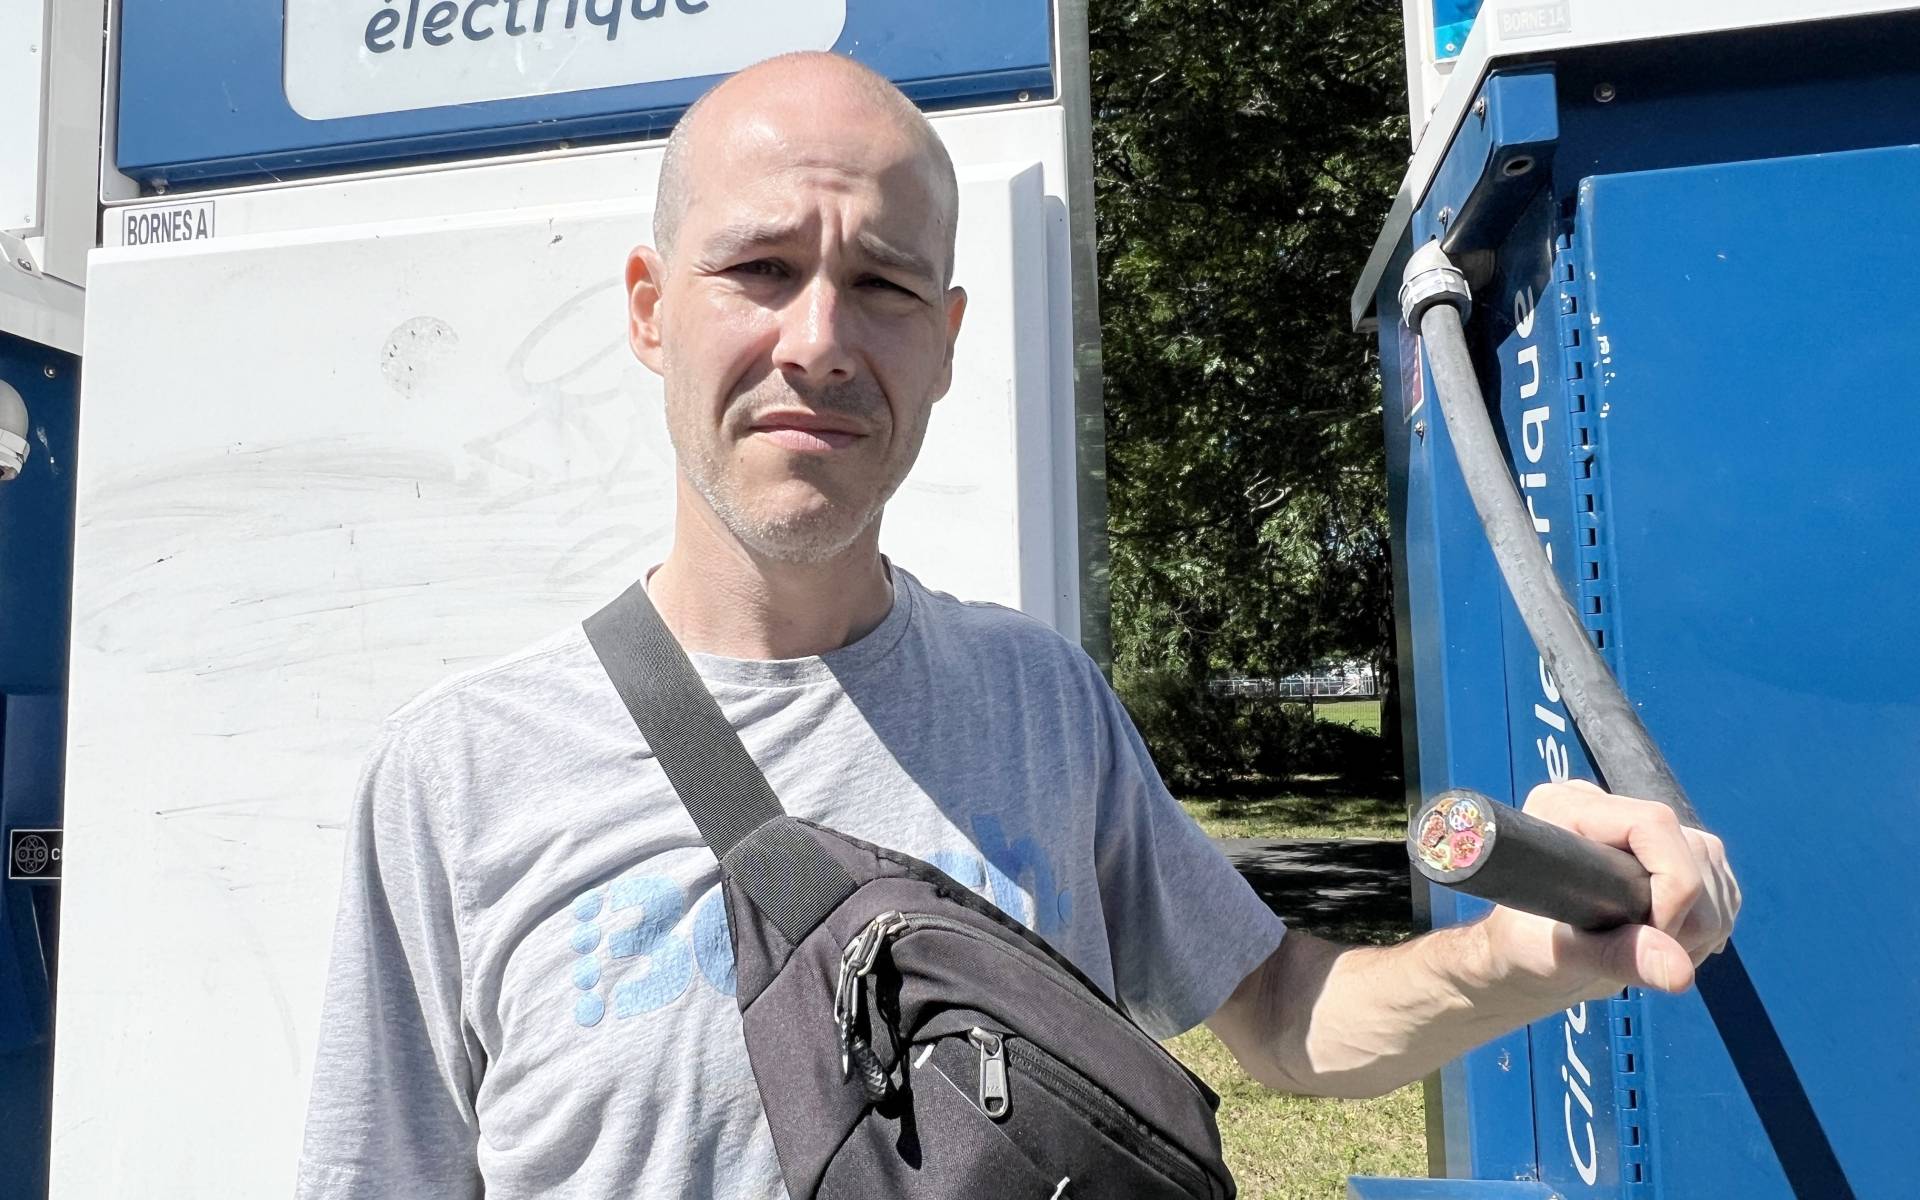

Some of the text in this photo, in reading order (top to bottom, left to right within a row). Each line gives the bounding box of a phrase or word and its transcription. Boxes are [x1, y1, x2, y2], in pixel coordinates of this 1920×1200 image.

[1503, 8, 1546, 33] BORNE
[127, 207, 208, 246] BORNES A
[1562, 1001, 1597, 1187] Circ
